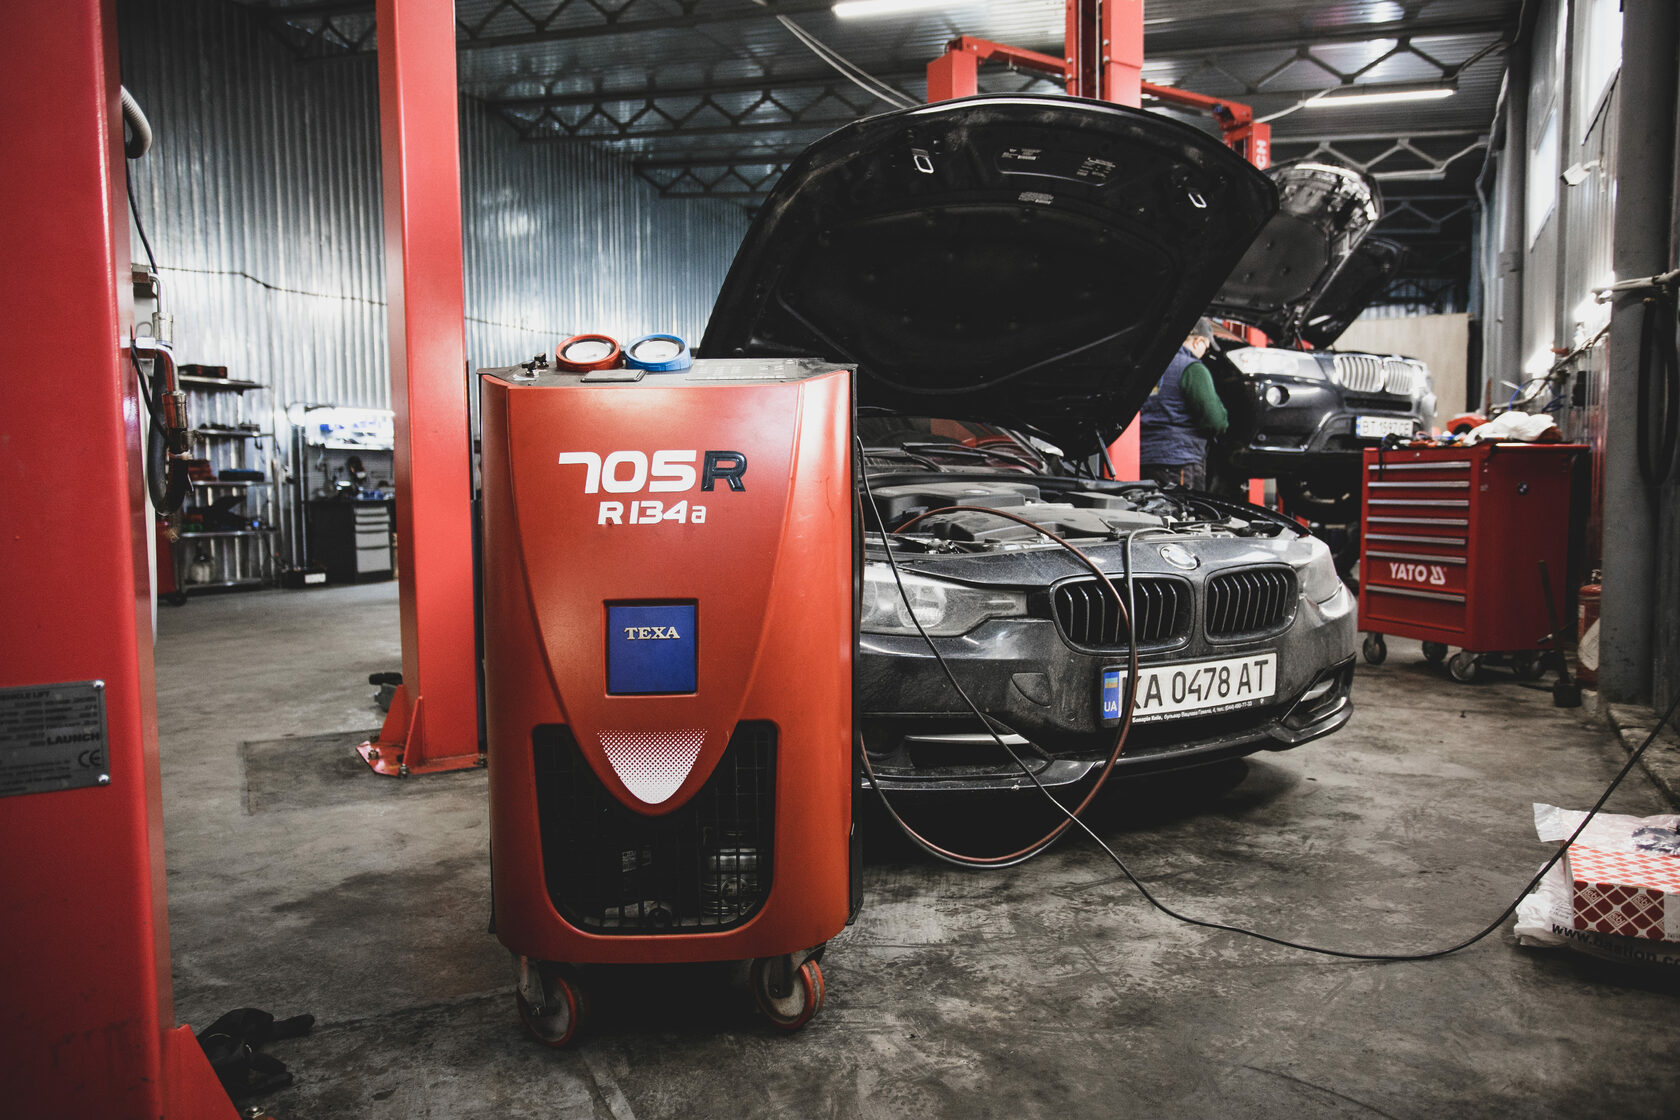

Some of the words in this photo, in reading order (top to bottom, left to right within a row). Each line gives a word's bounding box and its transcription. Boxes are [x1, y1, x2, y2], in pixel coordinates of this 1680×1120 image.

[1389, 562, 1428, 583] YATO
[624, 626, 681, 641] TEXA
[1171, 666, 1231, 704] 0478
[1237, 659, 1269, 696] AT
[1104, 700, 1118, 712] UA
[47, 732, 100, 746] LAUNCH
